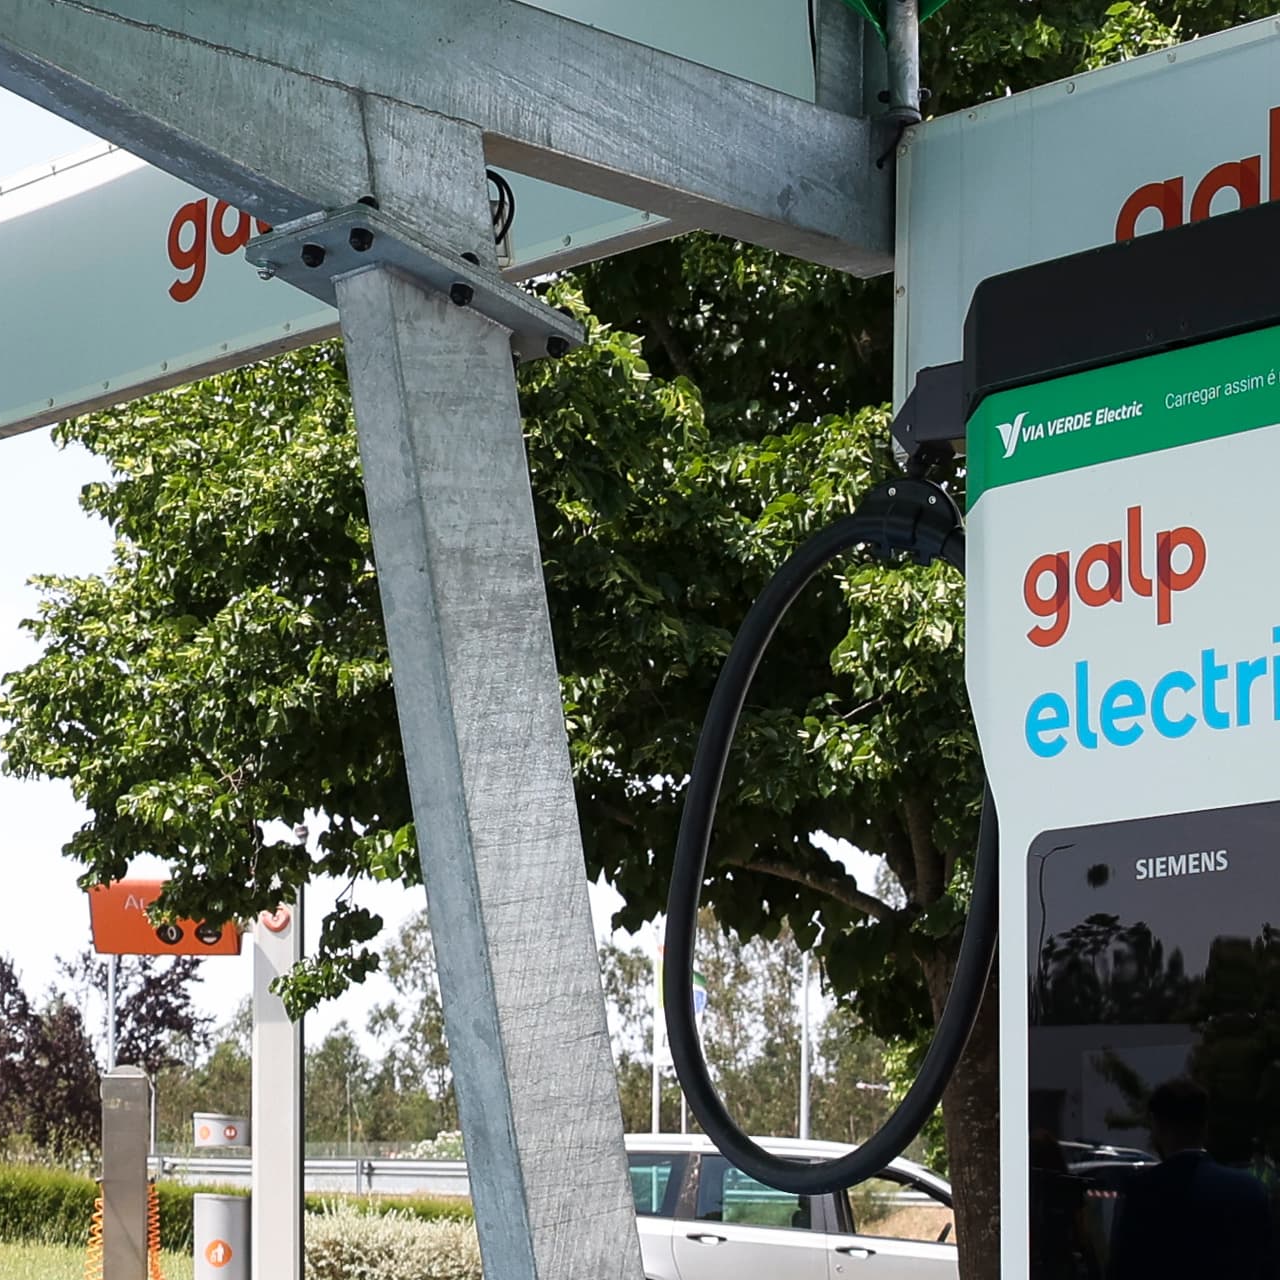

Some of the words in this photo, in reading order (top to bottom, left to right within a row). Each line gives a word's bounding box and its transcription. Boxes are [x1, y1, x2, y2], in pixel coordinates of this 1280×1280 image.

[167, 197, 273, 302] ga
[1021, 424, 1045, 444] VIA
[1047, 411, 1092, 437] VERDE
[1095, 400, 1144, 426] Electric
[1165, 384, 1221, 410] Carregar
[1224, 373, 1264, 396] assim
[1267, 370, 1276, 386] é
[1023, 505, 1207, 648] galp
[1135, 849, 1228, 880] SIEMENS
